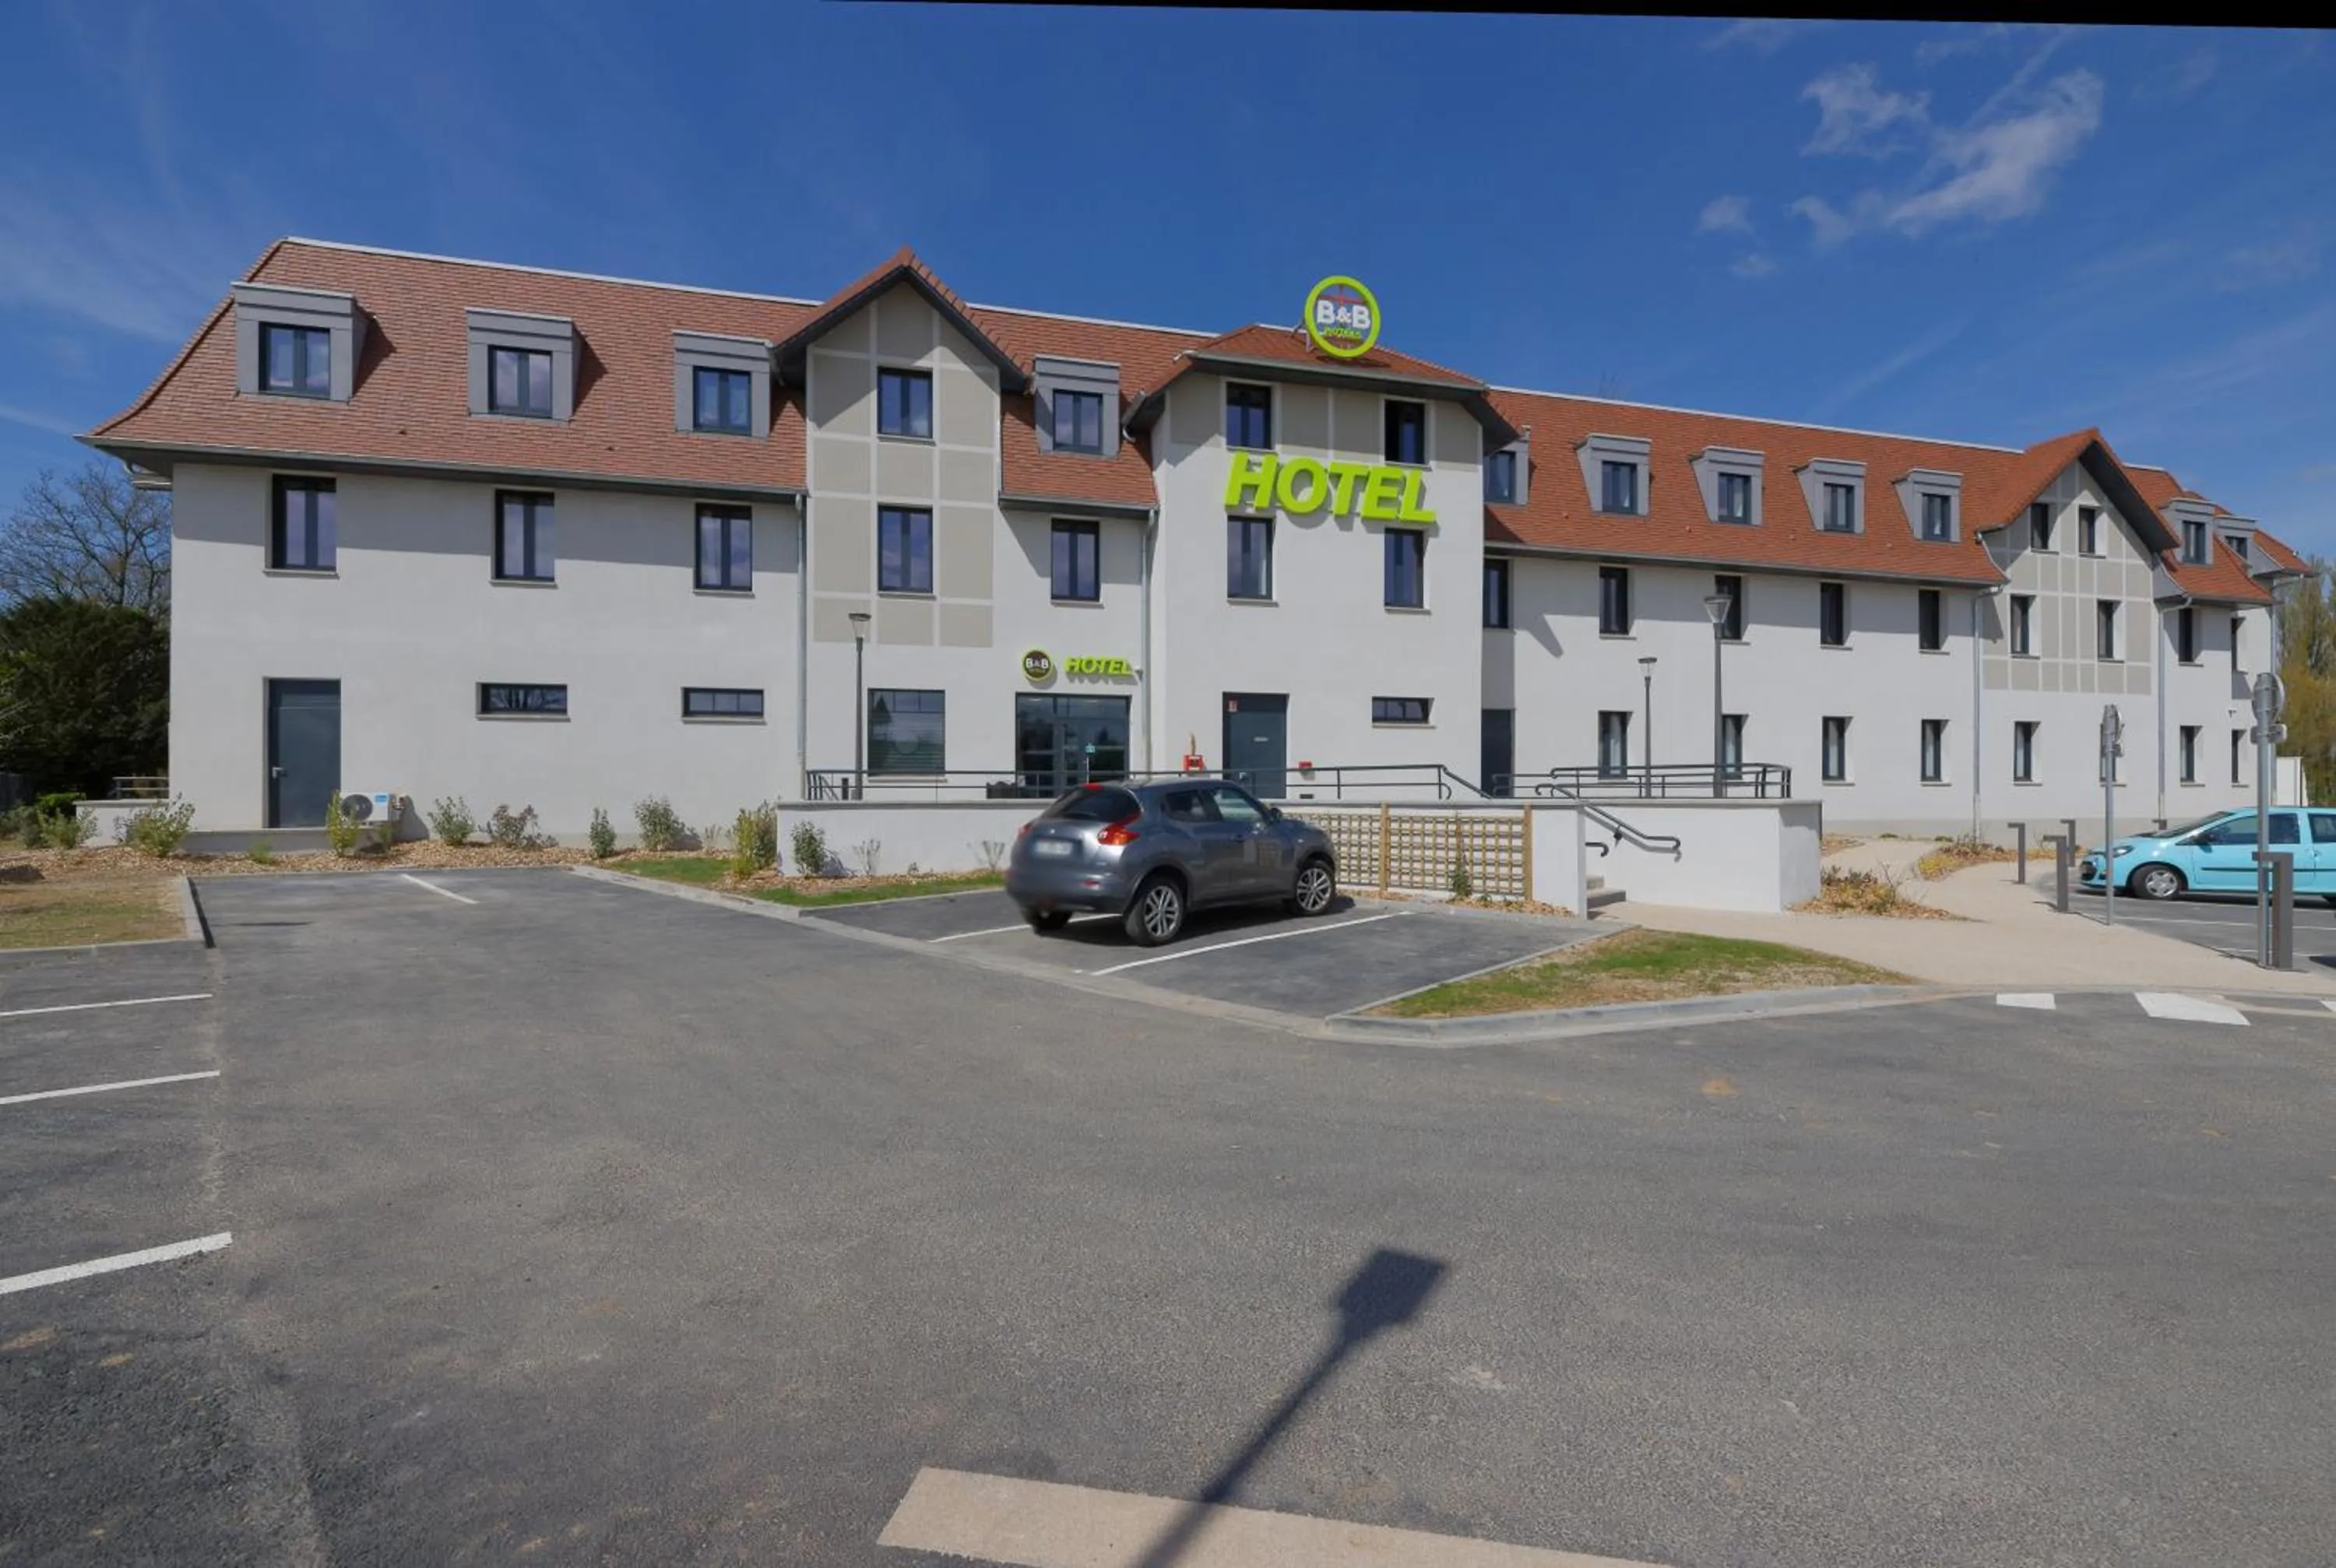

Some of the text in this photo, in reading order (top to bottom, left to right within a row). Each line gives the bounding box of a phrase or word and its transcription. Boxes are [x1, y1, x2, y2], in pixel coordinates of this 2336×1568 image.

[1317, 299, 1370, 329] B&B
[1224, 450, 1437, 522] HOTEL
[1026, 658, 1049, 669] B&B
[1064, 656, 1133, 675] HOTEL
